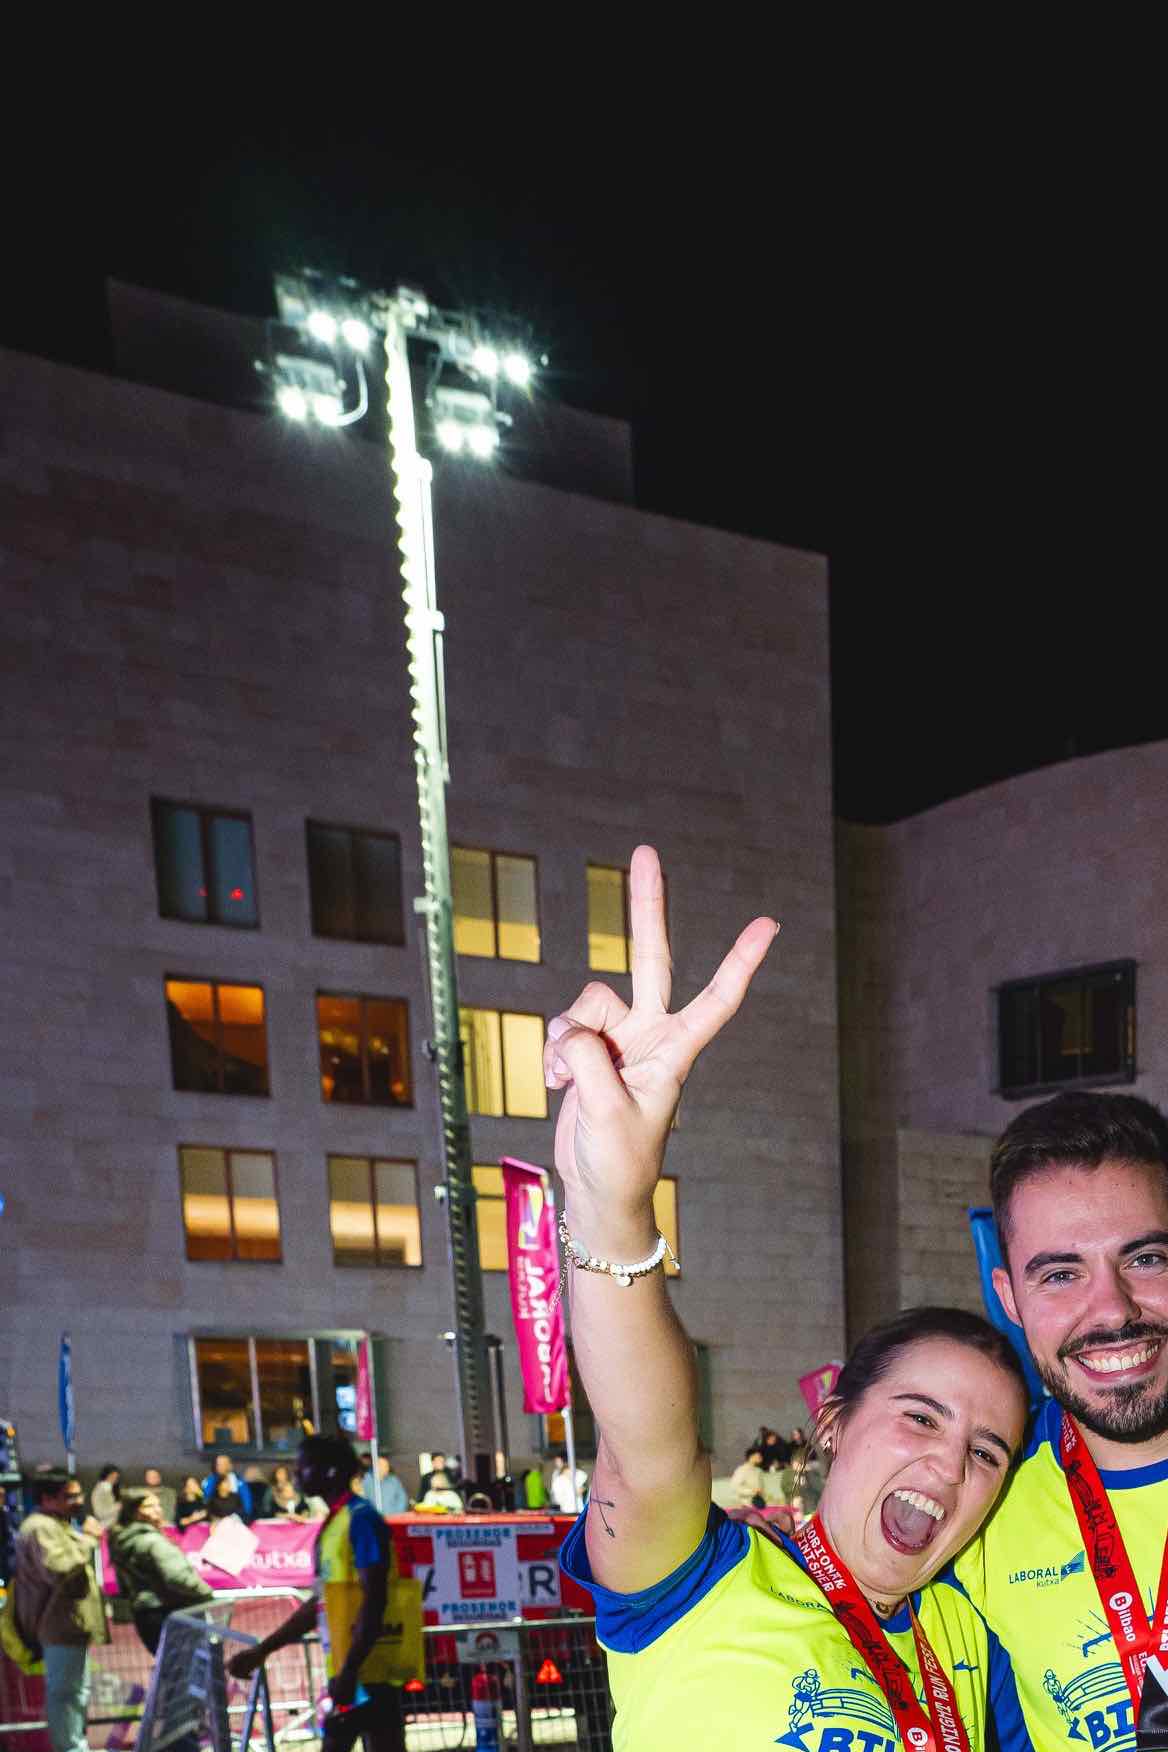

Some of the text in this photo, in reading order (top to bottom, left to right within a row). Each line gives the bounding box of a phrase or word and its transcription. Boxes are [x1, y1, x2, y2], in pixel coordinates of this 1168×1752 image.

[797, 1530, 834, 1592] INISHER
[1008, 1567, 1058, 1585] LABORAL
[442, 1600, 516, 1614] PROSENOR
[1109, 1591, 1137, 1643] Bilbao
